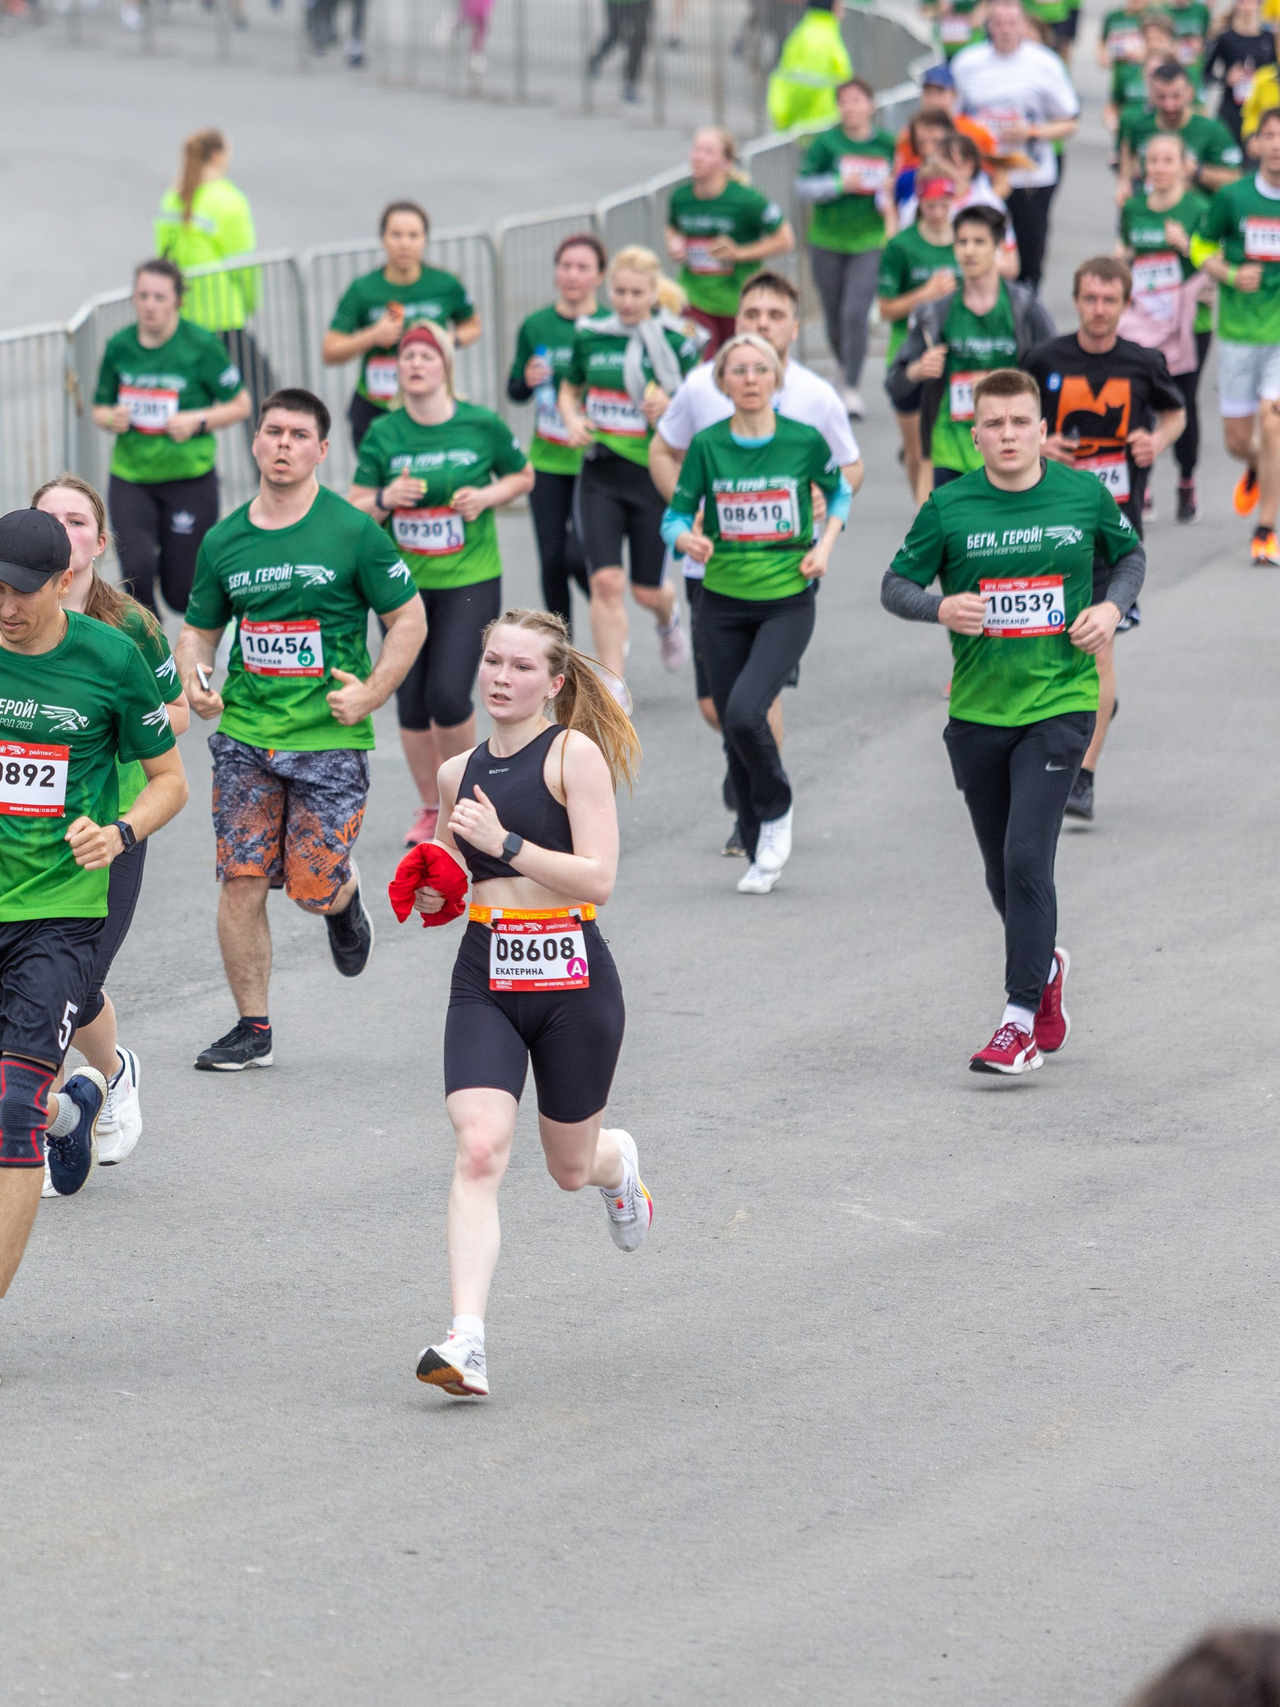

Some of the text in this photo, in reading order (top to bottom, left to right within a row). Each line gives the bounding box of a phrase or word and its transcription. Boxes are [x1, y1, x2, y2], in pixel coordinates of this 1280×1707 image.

[723, 504, 782, 522] 08610
[398, 520, 454, 538] 09301
[966, 525, 1043, 550] БЕГИ, ГЕРОЙ!
[228, 563, 293, 590] БЕГИ, ГЕРОЙ!
[987, 592, 1055, 615] 10539
[987, 617, 1030, 626] АЛЕКСАНДР
[245, 635, 312, 655] 10454
[15, 719, 34, 731] 2023
[496, 936, 575, 962] 08608
[495, 967, 544, 976] ЕКАТЕРИНА
[570, 960, 583, 976] A
[58, 1000, 79, 1051] 5
